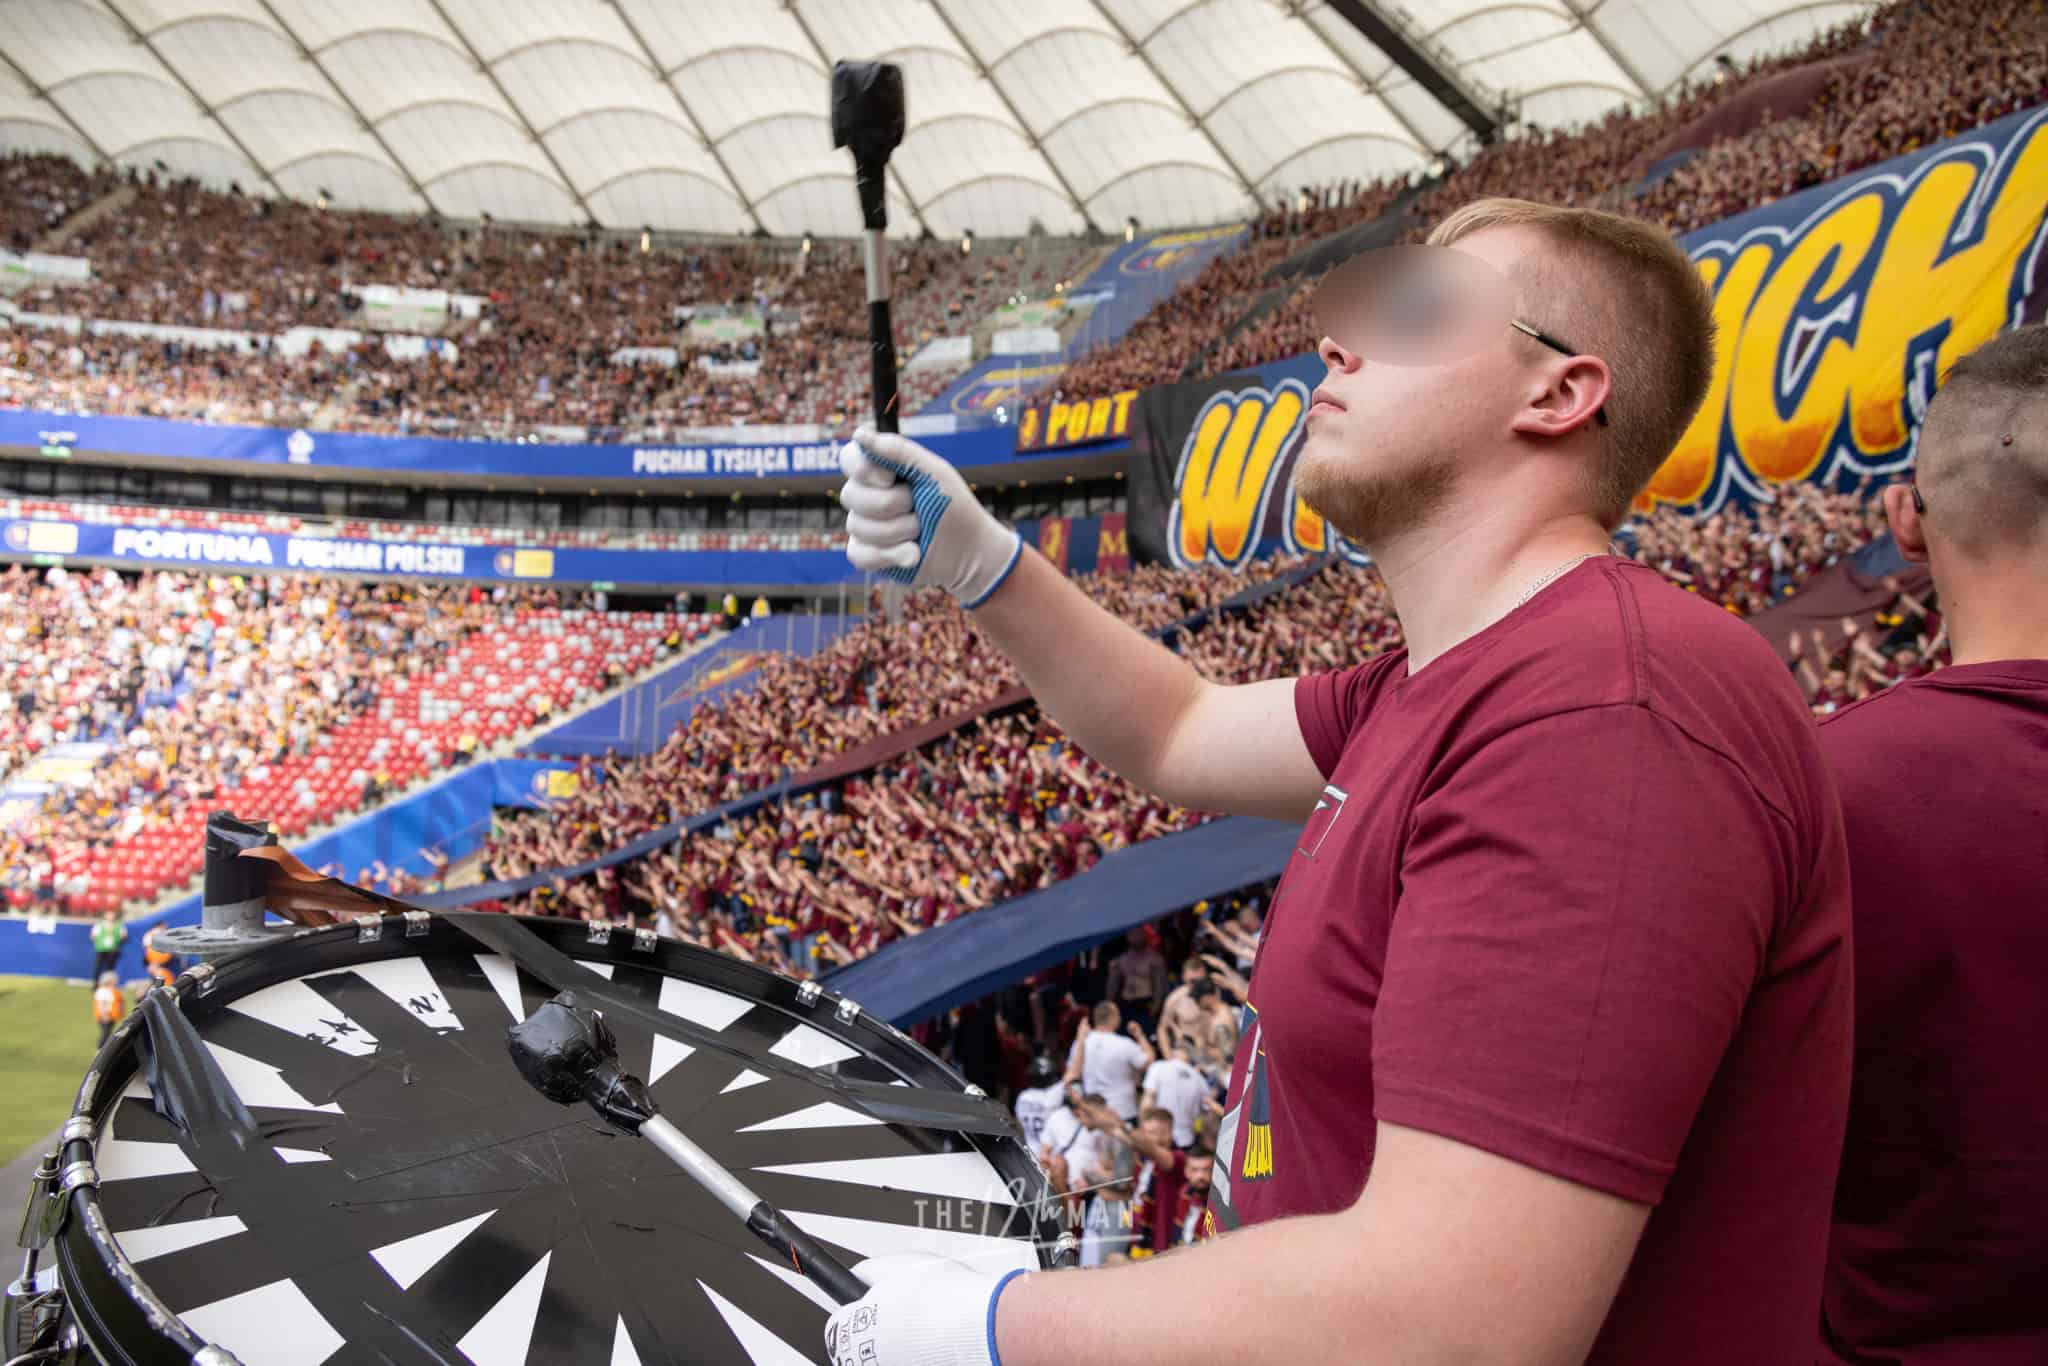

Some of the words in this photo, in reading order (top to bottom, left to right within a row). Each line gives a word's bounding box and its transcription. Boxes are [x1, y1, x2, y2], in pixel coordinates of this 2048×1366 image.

[633, 448, 708, 473] PUCHAR
[711, 447, 789, 478] TYSIĄCA
[112, 527, 273, 564] FORTUNA
[286, 538, 382, 570] PUCHAR
[385, 544, 465, 575] POLSKI
